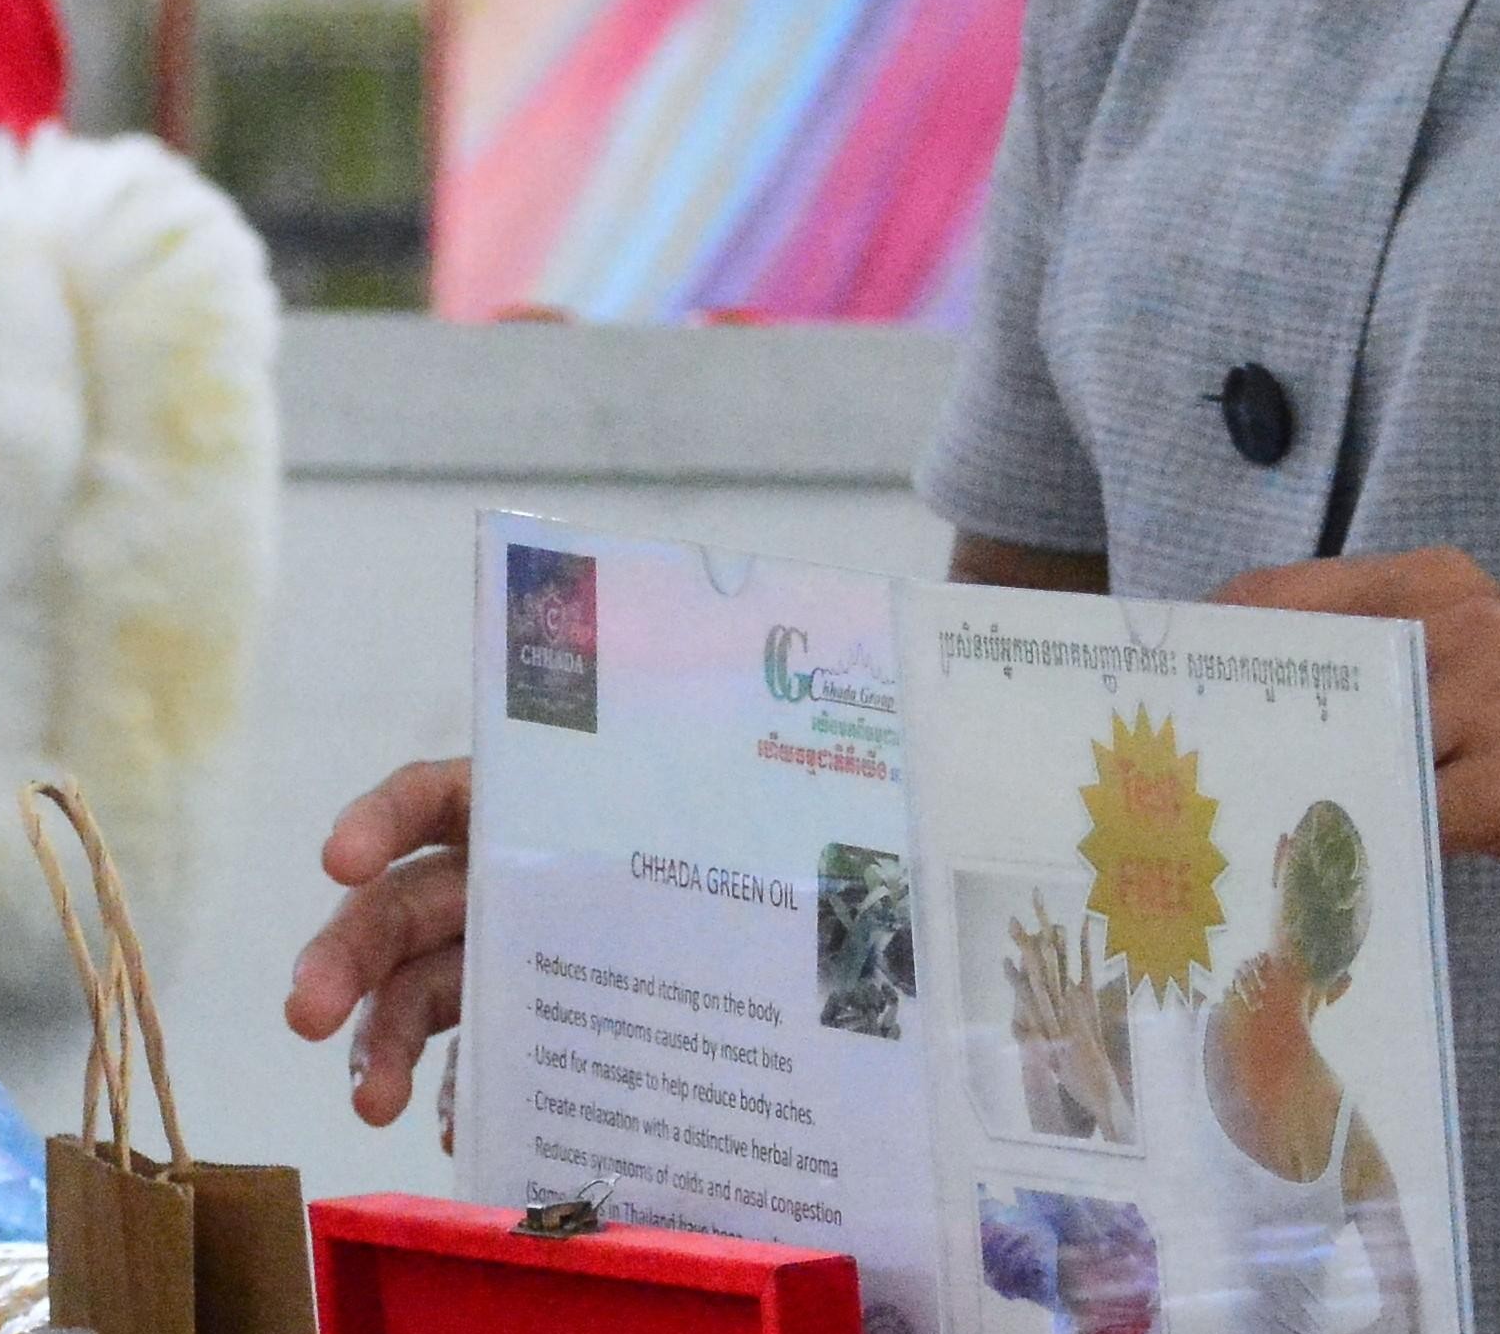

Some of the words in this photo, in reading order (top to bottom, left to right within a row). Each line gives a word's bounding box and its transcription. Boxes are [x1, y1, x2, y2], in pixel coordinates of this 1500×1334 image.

[519, 643, 585, 676] CHHADA
[630, 850, 701, 892] CHHADA
[705, 867, 765, 905] GREEN
[768, 880, 800, 911] OIL
[534, 952, 588, 980] Reduces
[590, 969, 630, 991] rashes
[632, 975, 656, 997] and
[658, 979, 700, 1012] itching
[703, 994, 721, 1009] on
[723, 992, 746, 1015] the
[748, 998, 783, 1028] body.
[534, 998, 588, 1028] Reduces
[590, 1014, 652, 1045] symptoms
[655, 1029, 698, 1054] caused
[702, 1034, 718, 1061] by
[721, 1039, 758, 1067] insect
[762, 1044, 793, 1074] bites
[534, 1045, 568, 1070] Used
[570, 1050, 587, 1073] for
[591, 1059, 644, 1092] massage
[646, 1072, 659, 1091] to
[661, 1074, 690, 1103] help
[692, 1082, 737, 1111] reduce
[740, 1086, 772, 1118] body
[775, 1099, 816, 1126] aches.
[534, 1090, 577, 1119] Create
[579, 1103, 640, 1133] relaxation
[642, 1115, 671, 1141] with
[672, 1129, 681, 1143] a
[683, 1123, 748, 1158] distinctive
[751, 1137, 793, 1167] herbal
[796, 1155, 839, 1179] aroma
[534, 1136, 588, 1167] Reduces
[656, 1165, 669, 1185] of
[672, 1168, 704, 1193] colds
[708, 1179, 731, 1200] and
[734, 1184, 768, 1210] nasal
[771, 1190, 842, 1226] congestion
